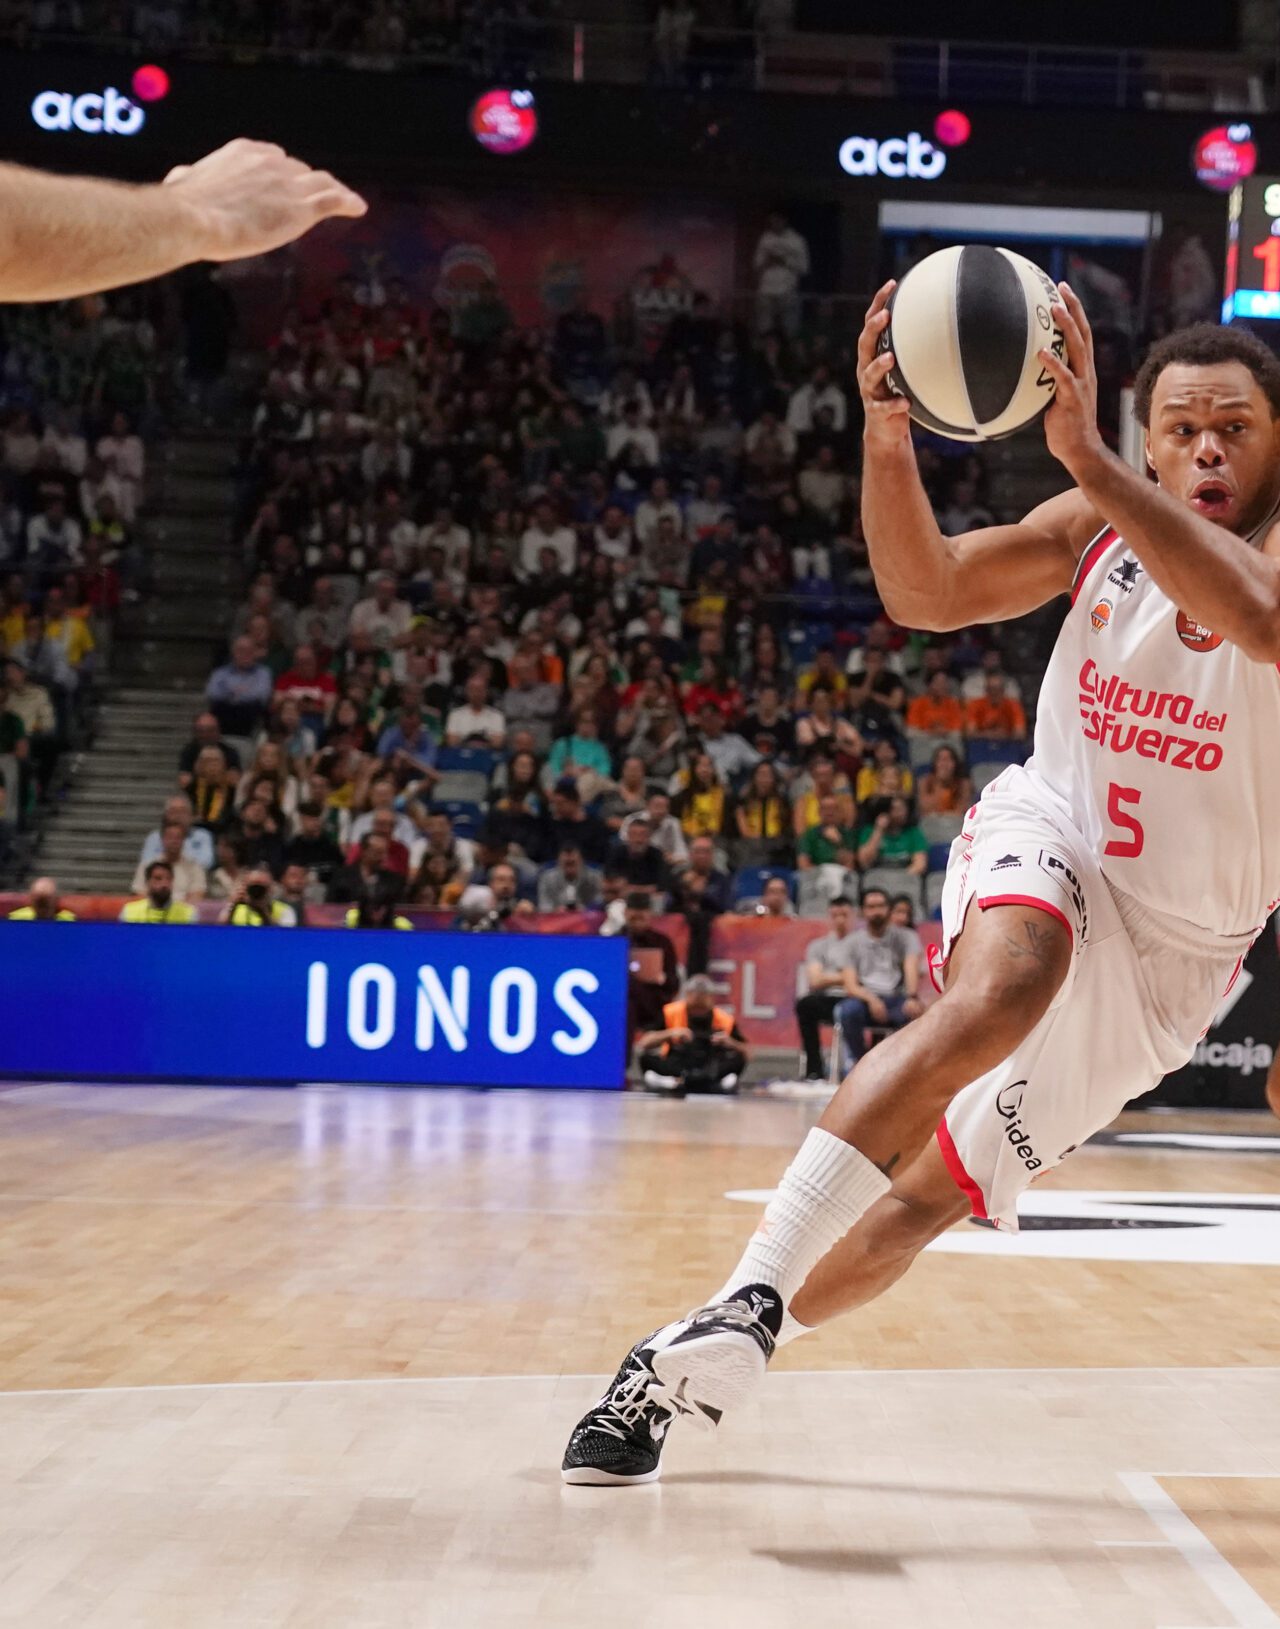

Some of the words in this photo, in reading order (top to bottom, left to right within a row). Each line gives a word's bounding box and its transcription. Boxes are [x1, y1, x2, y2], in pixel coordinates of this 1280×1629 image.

[32, 88, 145, 136] acb
[839, 132, 946, 180] acb
[1078, 658, 1193, 725] Cultura
[1193, 710, 1226, 732] del
[1104, 782, 1144, 858] 5
[307, 961, 599, 1056] IONOS
